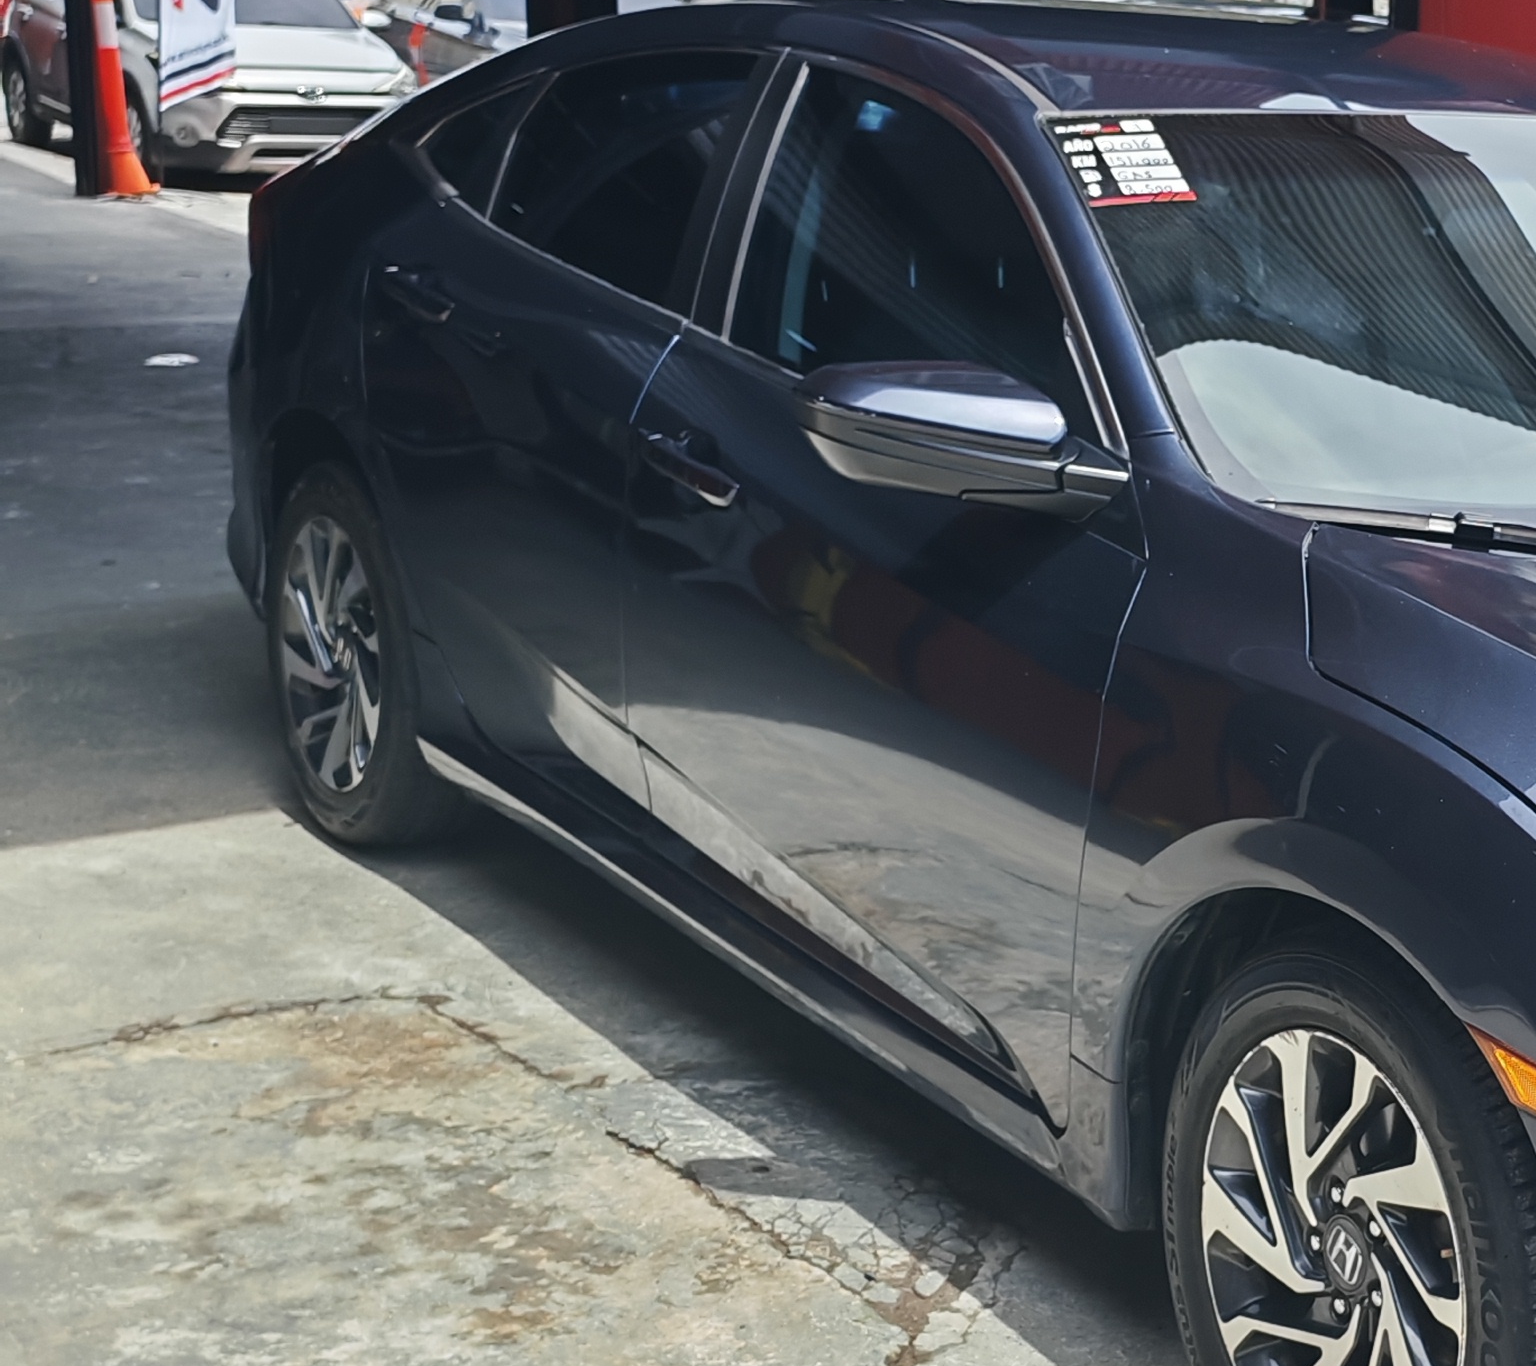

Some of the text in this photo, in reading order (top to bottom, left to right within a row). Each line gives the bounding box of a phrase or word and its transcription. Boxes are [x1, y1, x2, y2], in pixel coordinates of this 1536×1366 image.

[1101, 138, 1151, 152] 2016
[1070, 154, 1097, 168] KM
[1117, 170, 1153, 180] GAS
